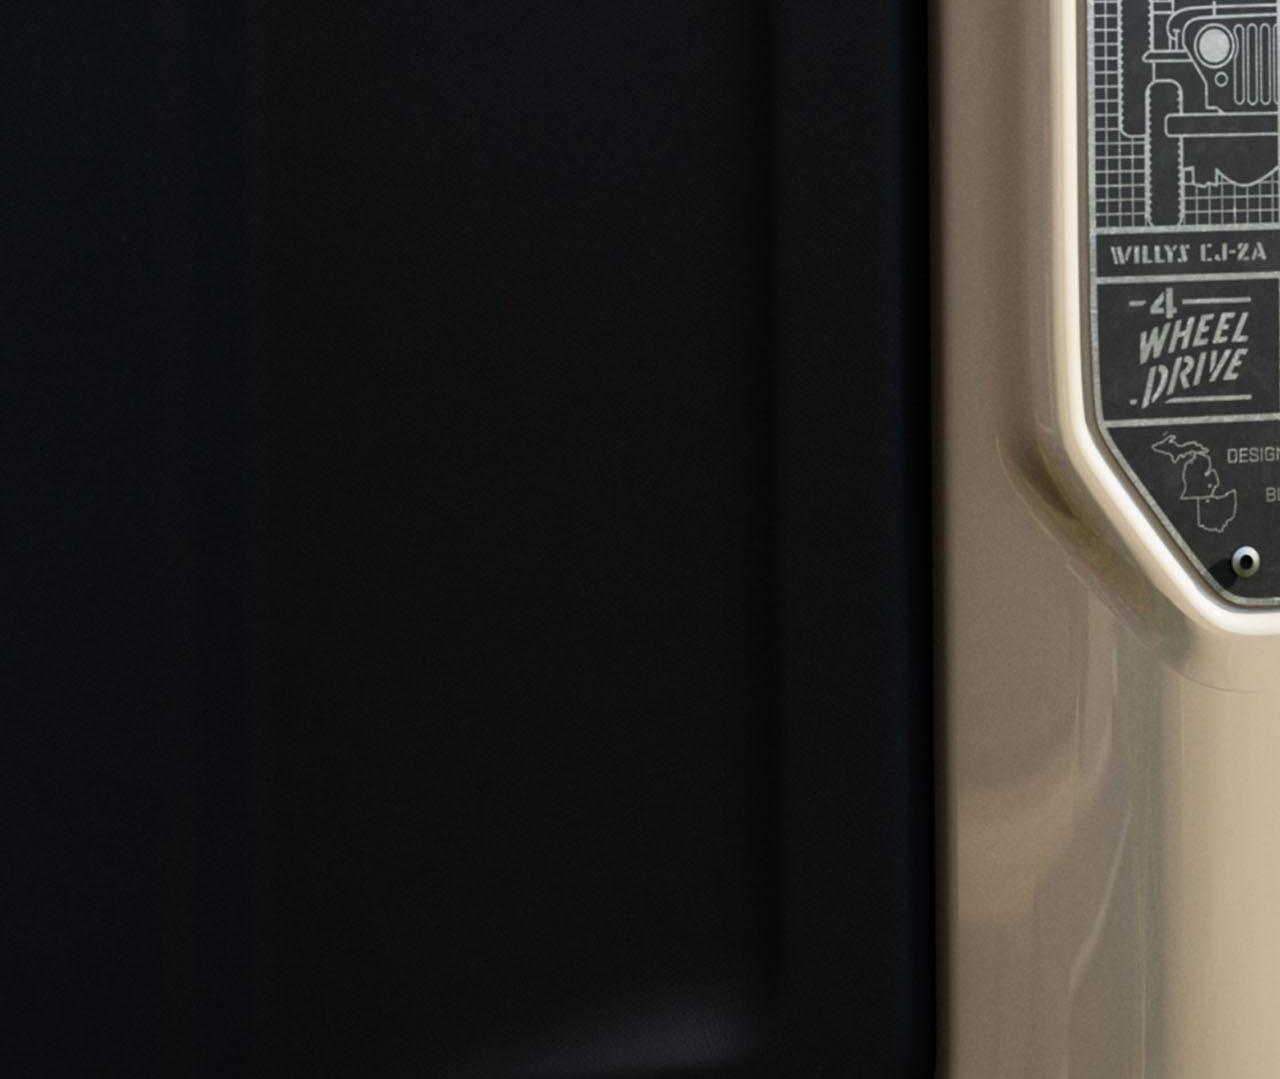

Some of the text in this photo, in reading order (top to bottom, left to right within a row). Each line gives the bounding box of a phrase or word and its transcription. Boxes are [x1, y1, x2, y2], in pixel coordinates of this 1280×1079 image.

[1110, 241, 1268, 266] WILLYS CJ-2A
[1139, 311, 1249, 366] WHEEL
[1140, 348, 1249, 410] DRIVE
